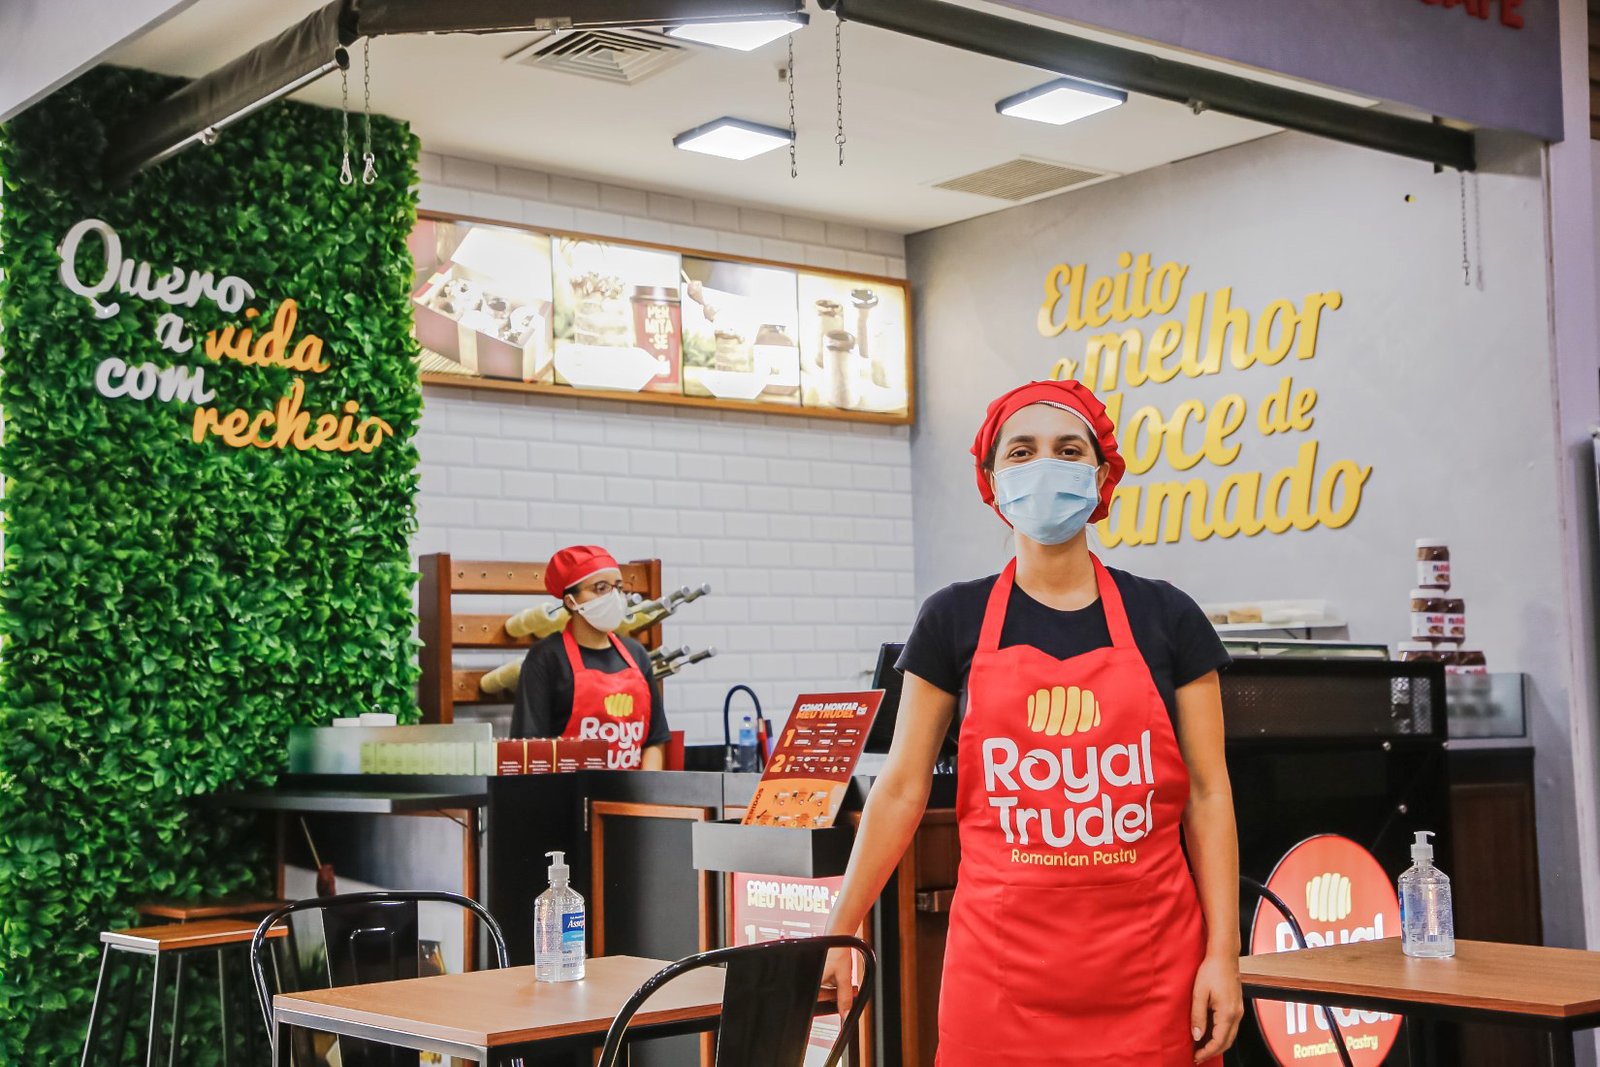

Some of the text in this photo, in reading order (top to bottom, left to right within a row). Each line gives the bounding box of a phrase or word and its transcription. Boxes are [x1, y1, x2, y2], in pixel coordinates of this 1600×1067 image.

[58, 218, 255, 319] Quero
[1037, 251, 1189, 337] Eleito
[155, 298, 330, 373] a vida
[1084, 286, 1343, 392] melhor
[96, 357, 216, 404] com
[1256, 376, 1318, 436] de
[193, 377, 394, 453] recheio
[1096, 440, 1373, 549] amado
[824, 702, 859, 710] MONTAR
[769, 754, 786, 773] 2
[783, 729, 796, 748] 1
[982, 730, 1155, 803] Royal
[988, 790, 1155, 848] Trudel
[1011, 848, 1137, 866] Romanian Pastry
[746, 880, 829, 900] COMO MONTAR
[747, 892, 830, 914] MEU TRUDEL
[1346, 1034, 1378, 1051] Pastry
